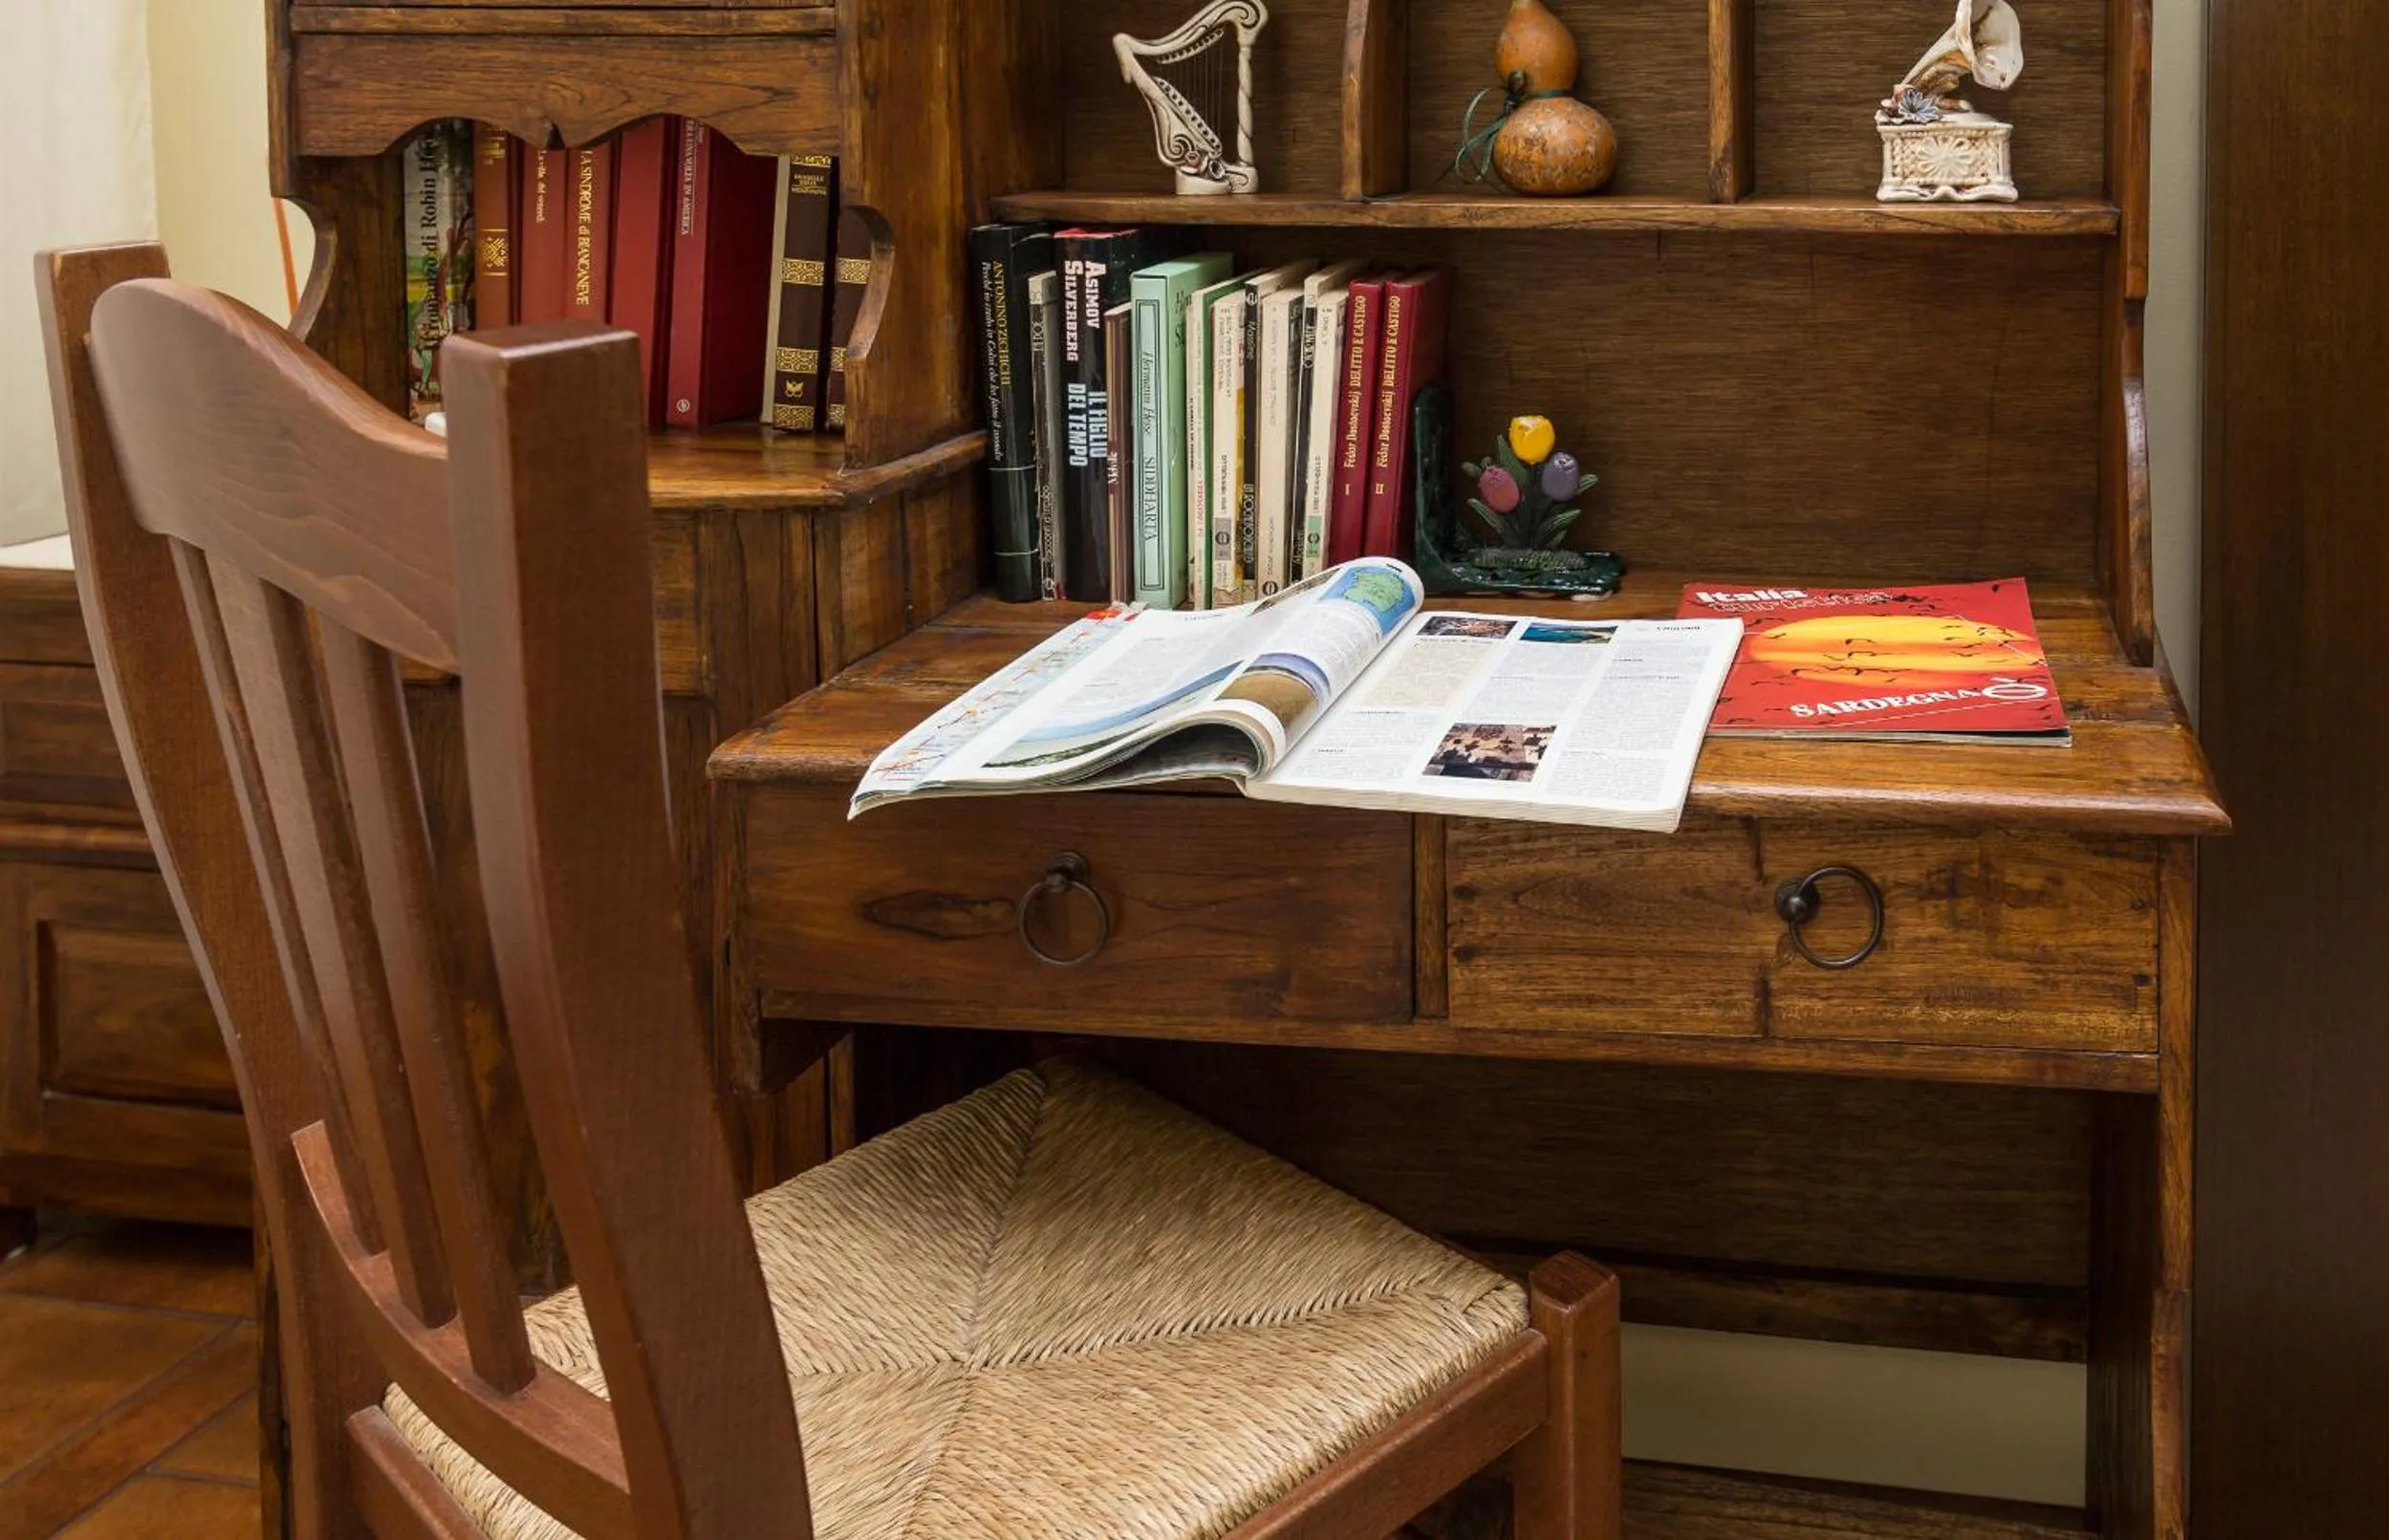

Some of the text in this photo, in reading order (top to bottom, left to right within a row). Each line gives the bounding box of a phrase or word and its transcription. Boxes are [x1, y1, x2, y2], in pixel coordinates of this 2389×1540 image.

[683, 157, 694, 183] VOLTA
[419, 179, 438, 228] Robin
[578, 166, 593, 224] SINDROME
[680, 196, 693, 236] AMERICA
[421, 235, 438, 250] di
[577, 226, 590, 235] di
[576, 237, 591, 305] BIANCANEVE
[1064, 260, 1084, 362] SILVERBERG
[1085, 260, 1107, 329] ASIMOV
[1352, 294, 1367, 337] CASTIGO
[1385, 294, 1401, 337] CASTIGO
[991, 261, 1011, 386] ANTONINO ZICHICHI
[1351, 336, 1364, 345] E
[1384, 336, 1399, 345] E
[1349, 346, 1364, 387] DELITTO
[1382, 345, 1398, 387] DELITTO
[1067, 383, 1089, 467] DEL TEMPO
[1089, 390, 1109, 459] IL FIGLIO
[1346, 391, 1362, 442] Dostoevskij
[1379, 391, 1396, 442] Dostoevskij
[1142, 351, 1158, 542] Hermann Hesse SIDDHARTA
[1107, 451, 1119, 485] Melville
[1345, 484, 1351, 496] I
[1375, 484, 1385, 495] II
[1695, 588, 1809, 604] Italia
[1790, 687, 1982, 718] SARDEGNA
